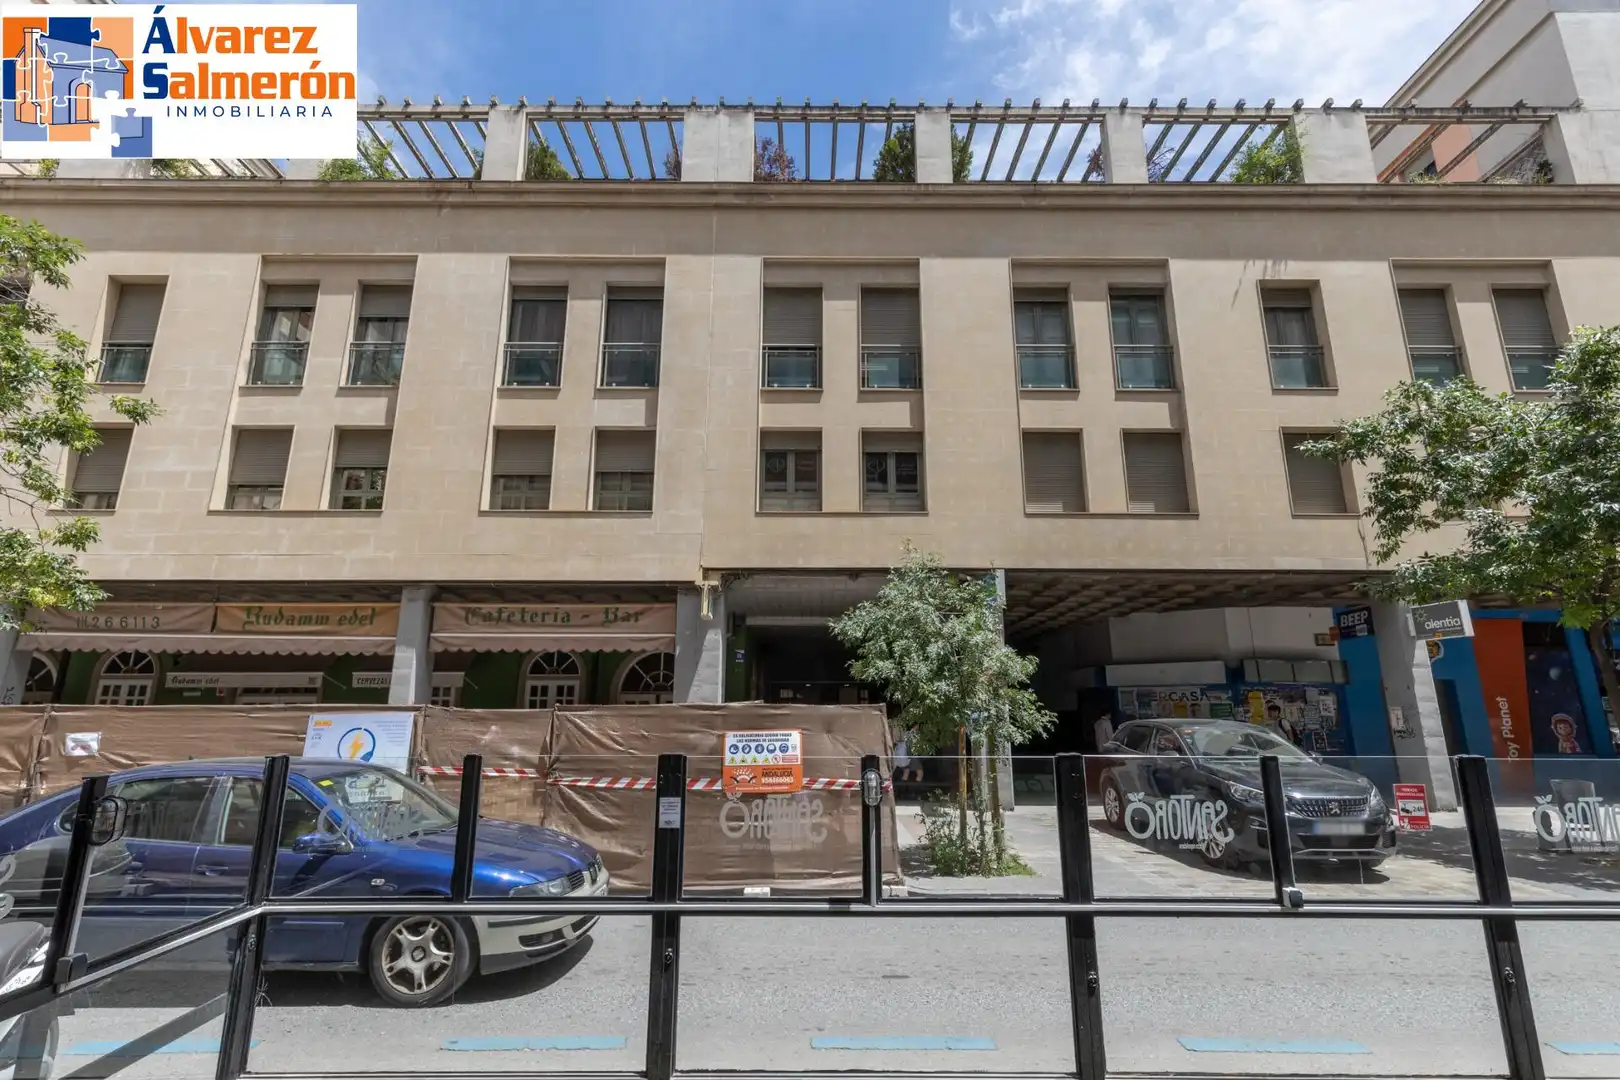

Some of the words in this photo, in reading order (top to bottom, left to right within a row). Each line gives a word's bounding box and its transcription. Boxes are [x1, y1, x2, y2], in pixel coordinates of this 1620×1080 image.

[603, 606, 645, 625] Bar
[1340, 610, 1368, 627] BEEP
[1424, 616, 1461, 630] alentia
[1496, 696, 1515, 738] Planet
